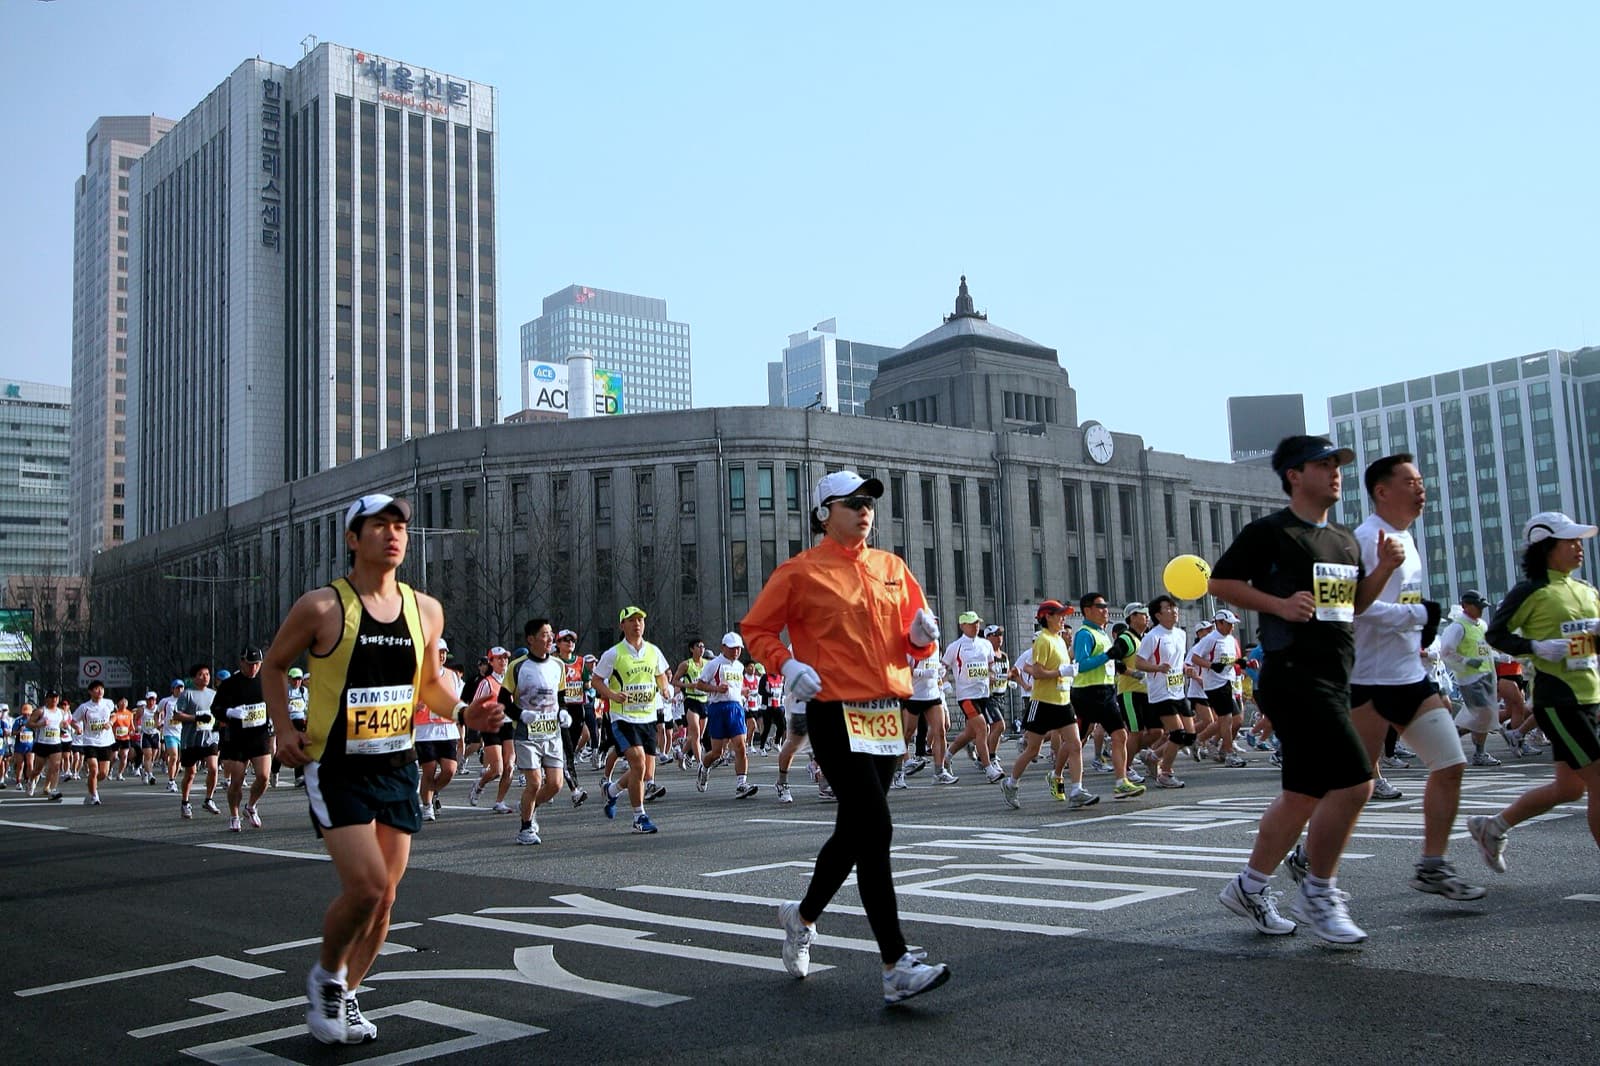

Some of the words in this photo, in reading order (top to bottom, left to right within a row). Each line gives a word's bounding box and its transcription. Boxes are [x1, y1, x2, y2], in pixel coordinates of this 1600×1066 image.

[363, 60, 470, 108] 서울신문
[536, 368, 554, 378] ACE
[349, 688, 413, 704] SAMSUNG
[354, 707, 408, 736] F4406
[848, 712, 898, 738] E7133
